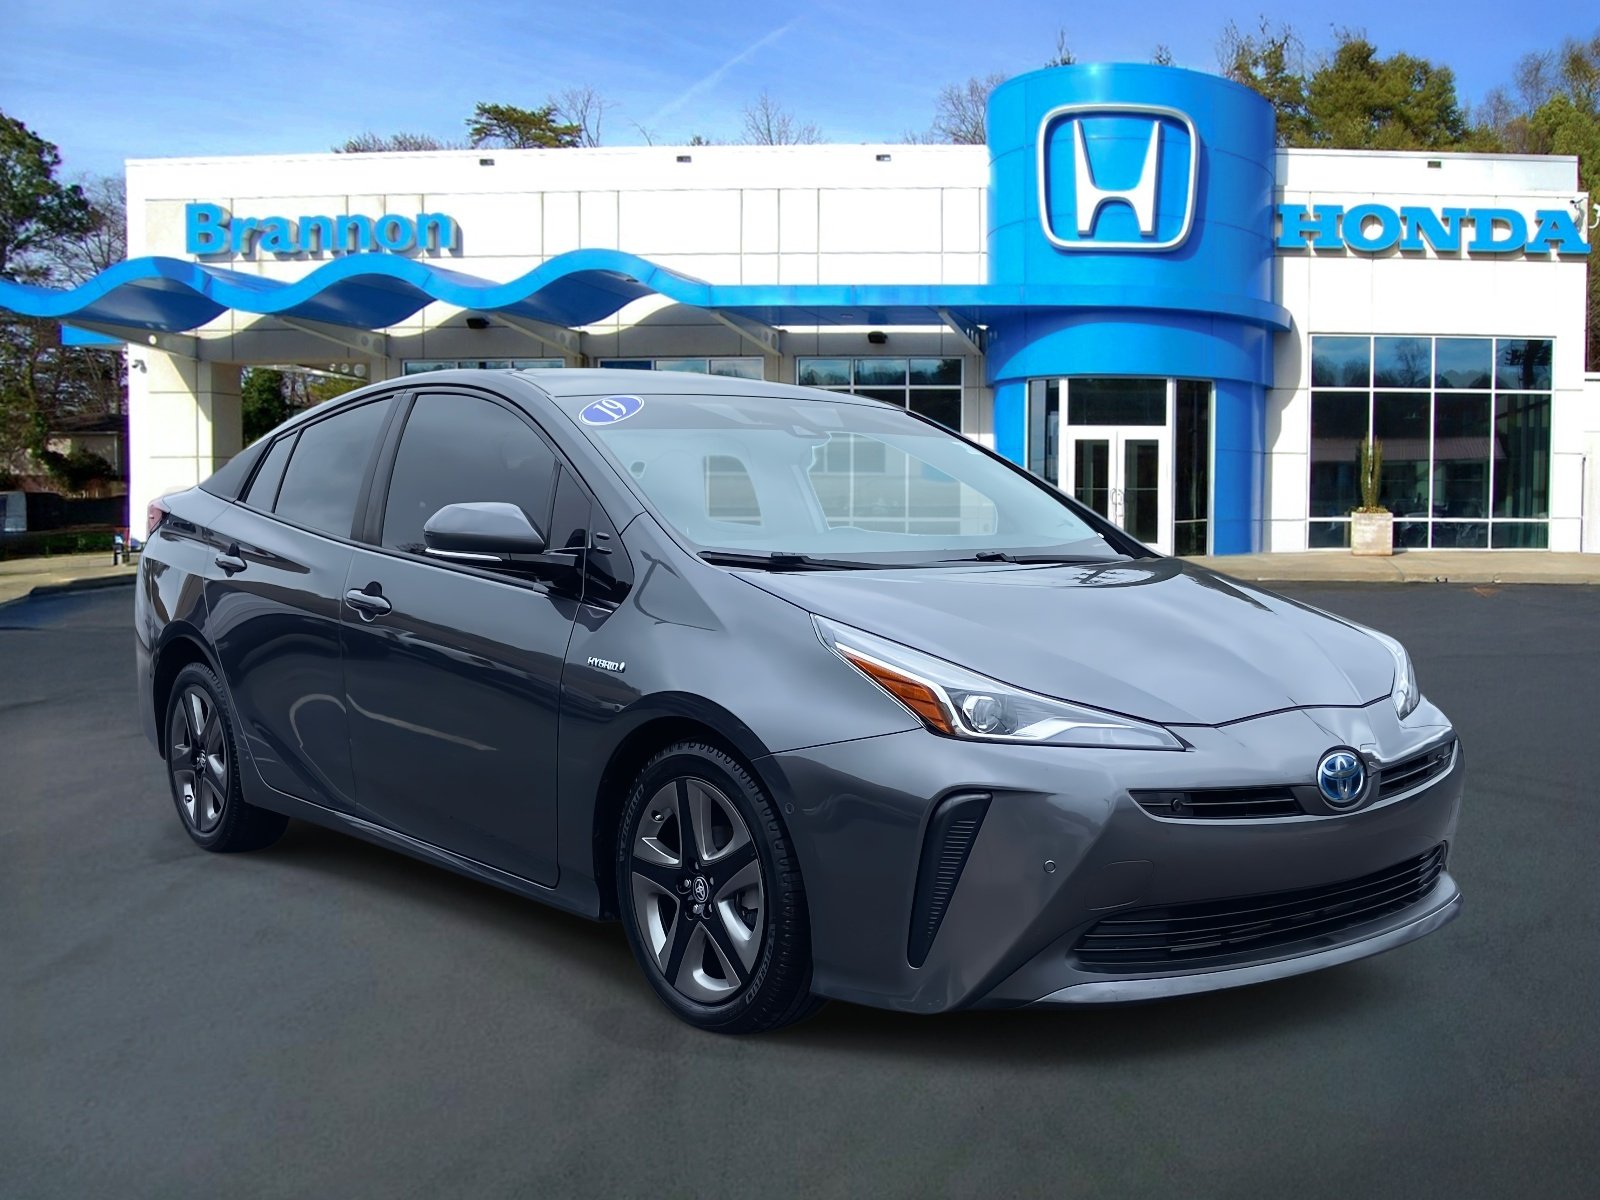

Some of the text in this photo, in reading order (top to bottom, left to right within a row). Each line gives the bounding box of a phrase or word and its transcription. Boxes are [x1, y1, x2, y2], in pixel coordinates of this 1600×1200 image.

[186, 202, 453, 254] Brannon
[1276, 203, 1591, 255] HONDA
[593, 399, 627, 421] 19
[587, 656, 619, 671] HYBRID
